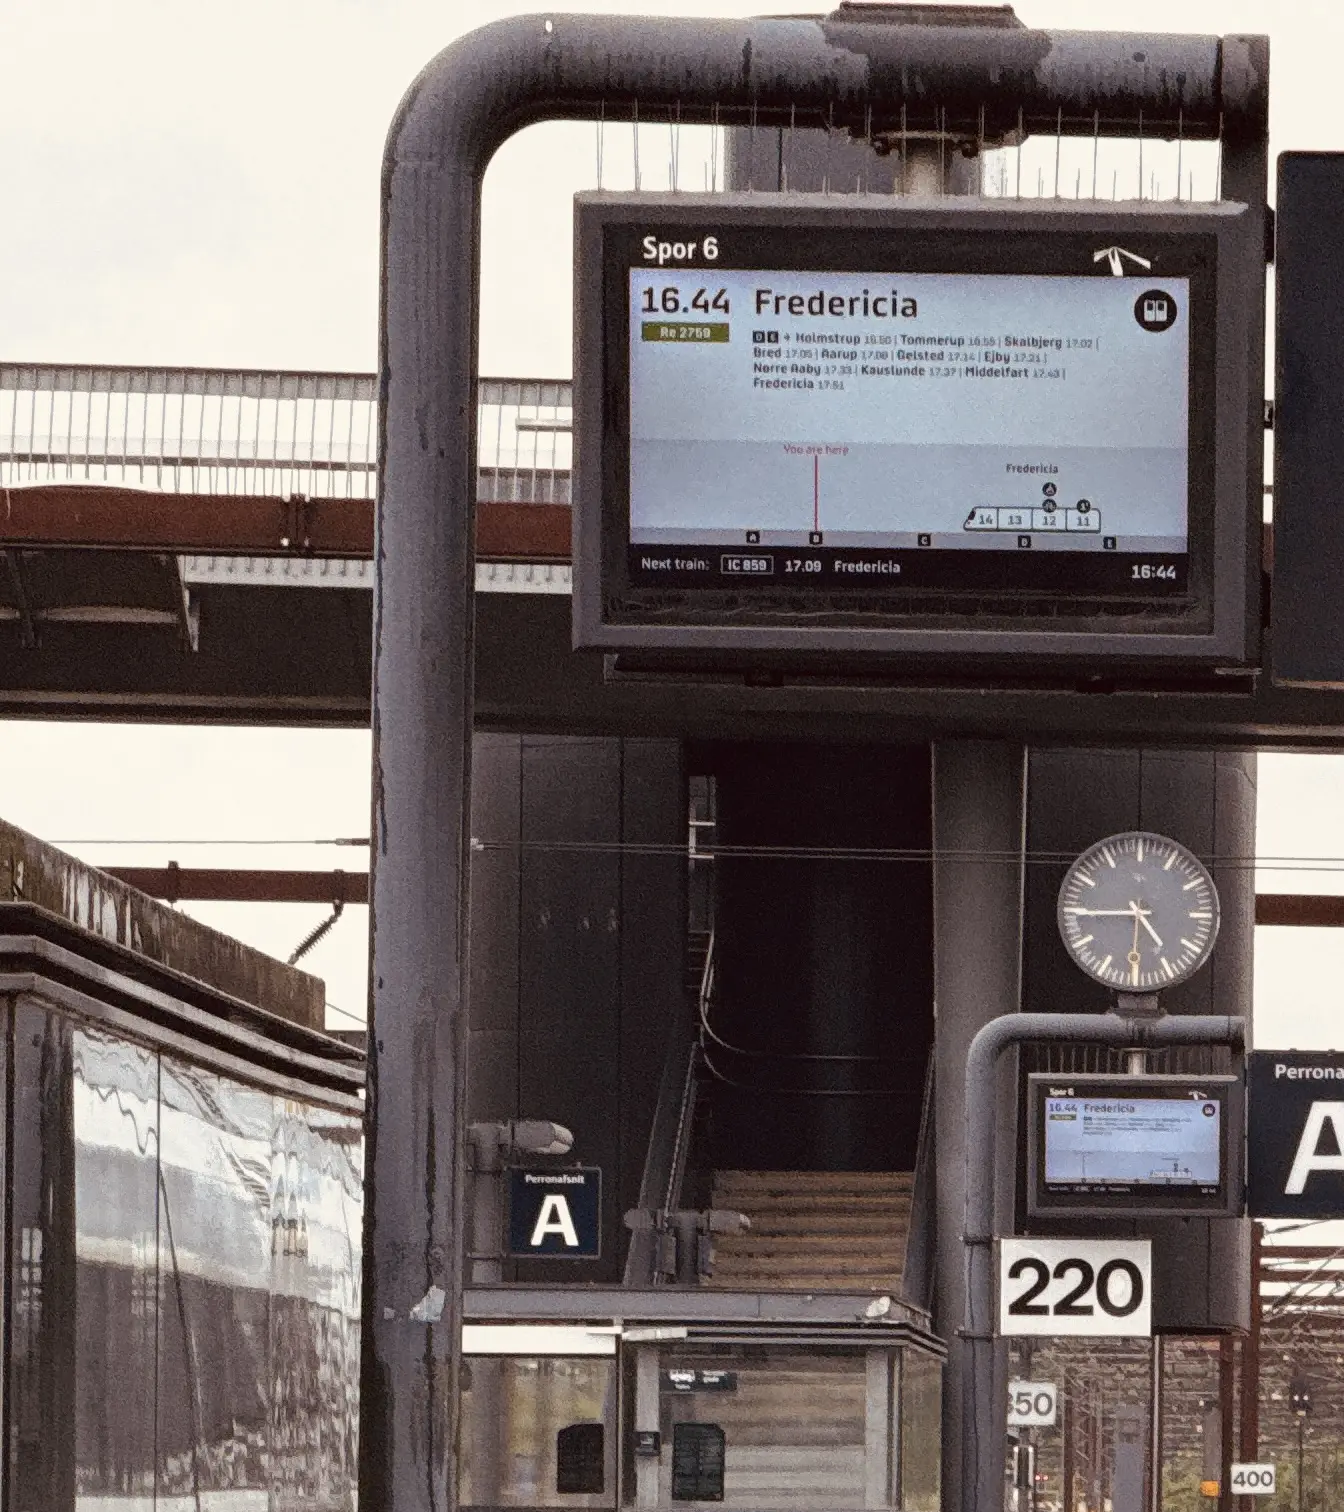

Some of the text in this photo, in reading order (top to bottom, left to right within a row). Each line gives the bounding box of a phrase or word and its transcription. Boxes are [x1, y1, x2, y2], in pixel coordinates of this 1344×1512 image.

[643, 236, 718, 265] Spor 6
[642, 287, 918, 317] 16.44 Fredericia
[660, 326, 676, 338] Re
[796, 332, 860, 346] Holmstrup
[901, 334, 964, 348] Tommerup
[1004, 336, 1062, 350] Skalbjerg
[753, 346, 782, 358] Bred
[821, 348, 858, 361] Aarup
[897, 350, 944, 361] Gelsted
[984, 351, 1010, 364] Ejby
[791, 364, 821, 376] Aaby
[861, 365, 926, 376] Kauslunde
[965, 366, 1029, 378] Middelfart
[753, 377, 815, 390] Fredericia
[783, 443, 804, 455] You
[806, 446, 823, 455] are
[1006, 463, 1059, 475] Fredericia
[979, 514, 1090, 527] 14 13 12 11
[642, 556, 901, 574] Next train: IC 859 17.09 Fredericia
[1131, 564, 1177, 580] 16:44
[1084, 1104, 1135, 1113] Fredericia
[525, 1174, 585, 1184] Perronafsnit
[531, 1194, 579, 1246] A
[1008, 1258, 1144, 1318] 220
[1008, 1391, 1053, 1416] 50
[1233, 1470, 1273, 1487] 400
